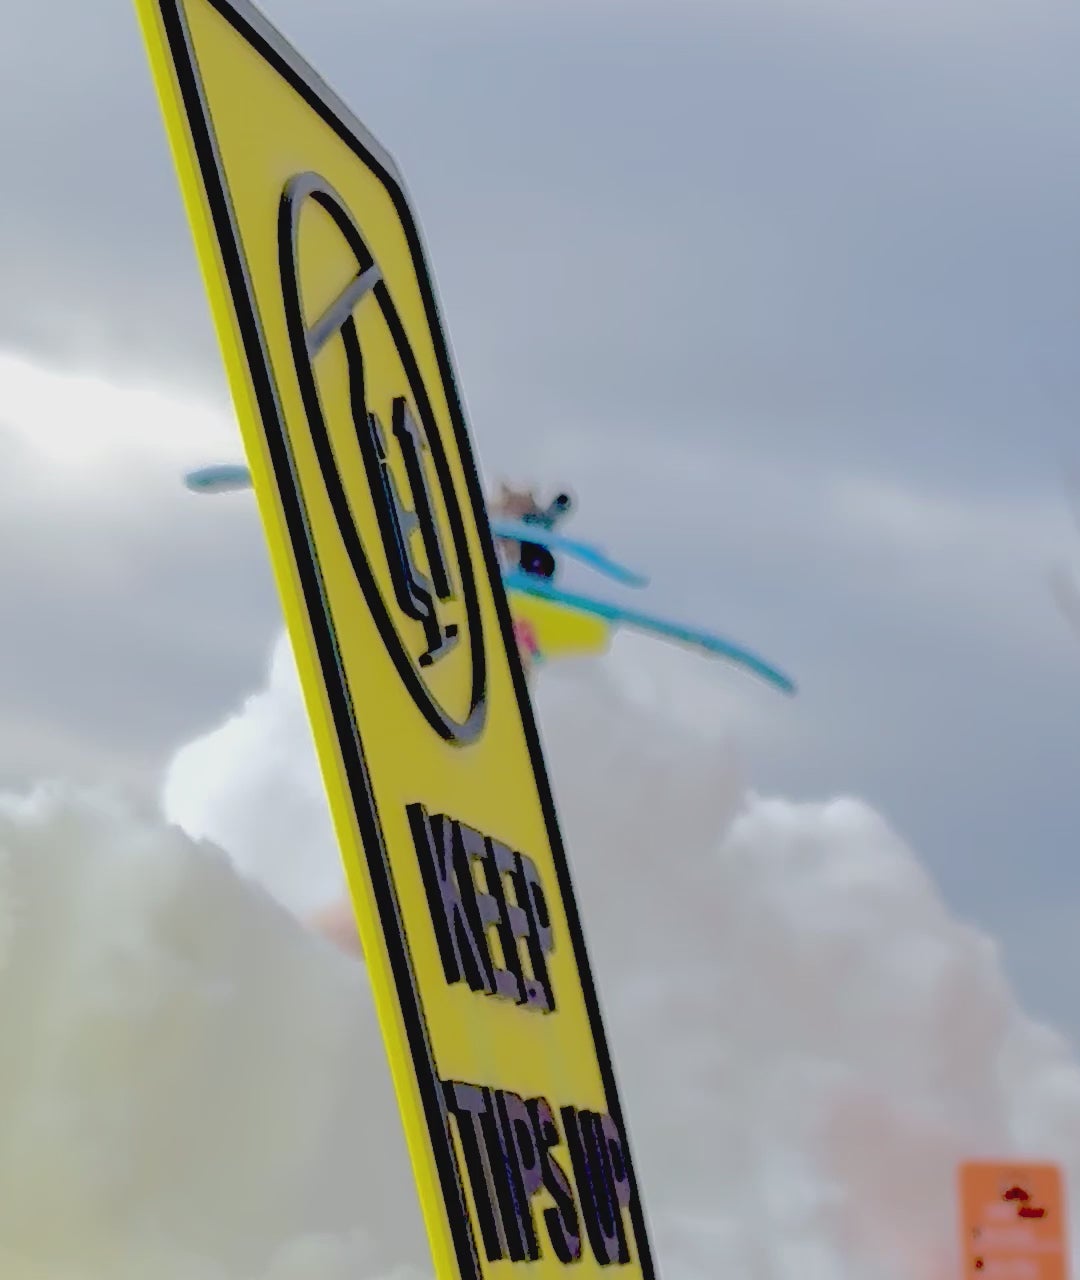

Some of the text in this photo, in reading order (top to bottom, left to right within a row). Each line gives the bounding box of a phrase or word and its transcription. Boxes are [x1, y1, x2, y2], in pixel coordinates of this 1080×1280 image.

[405, 803, 556, 1014] KEEP
[442, 1080, 632, 1266] TIPS UP
